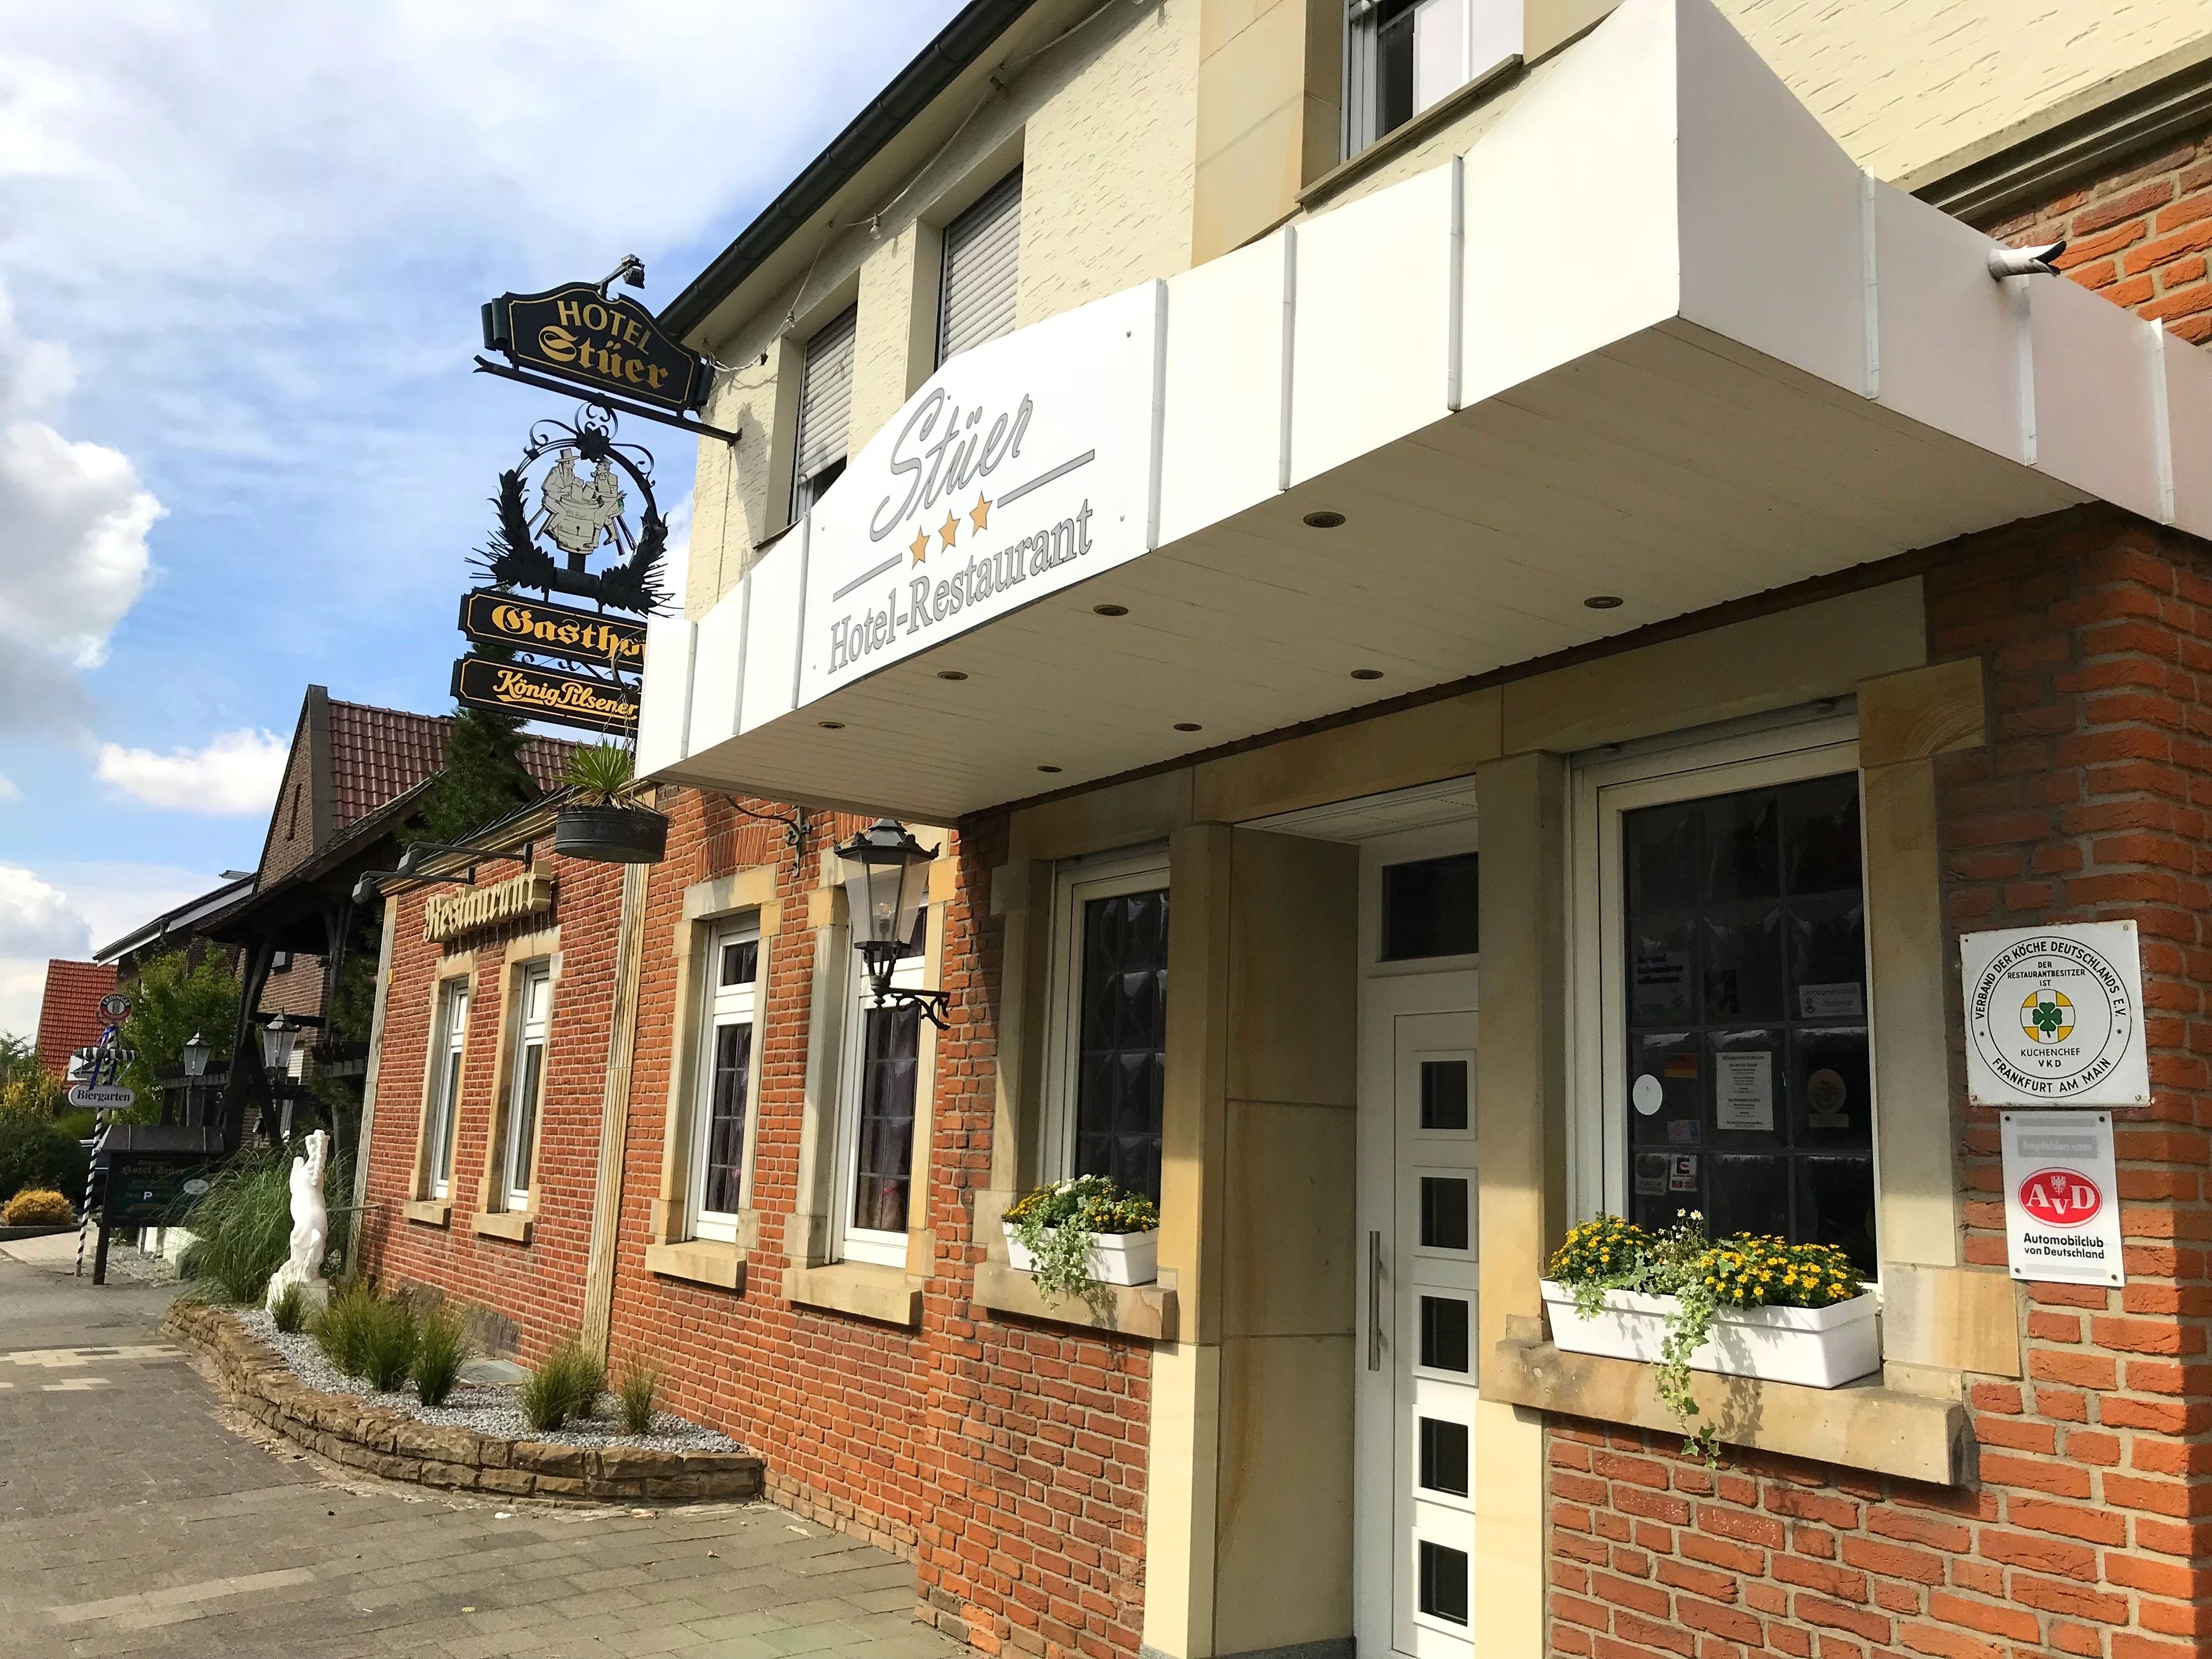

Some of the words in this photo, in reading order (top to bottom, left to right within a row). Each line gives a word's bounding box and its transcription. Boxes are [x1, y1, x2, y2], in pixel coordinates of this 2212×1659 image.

[557, 300, 652, 355] HOTEL
[539, 325, 669, 389] Stüer
[870, 388, 1033, 541] Stüer
[828, 499, 1093, 675] Hotel-Restaurant
[491, 605, 646, 660] Gastho
[423, 871, 539, 943] Restaurant
[1975, 973, 1995, 1019] VERBAND
[1993, 955, 2012, 974] DER
[2012, 941, 2047, 959] KÖCHE
[2051, 941, 2120, 993] DEUTSCHLANDS
[2113, 998, 2126, 1017] E.V.
[2008, 969, 2085, 979] RESTAURANTBESITZER
[76, 1089, 130, 1103] Biergarten
[1993, 1058, 2052, 1093] FRANKFURT
[2059, 1079, 2079, 1092] AM
[2081, 1058, 2111, 1084] MAIN
[2024, 1233, 2104, 1247] Automobilclub
[2044, 1247, 2104, 1259] Deutschland
